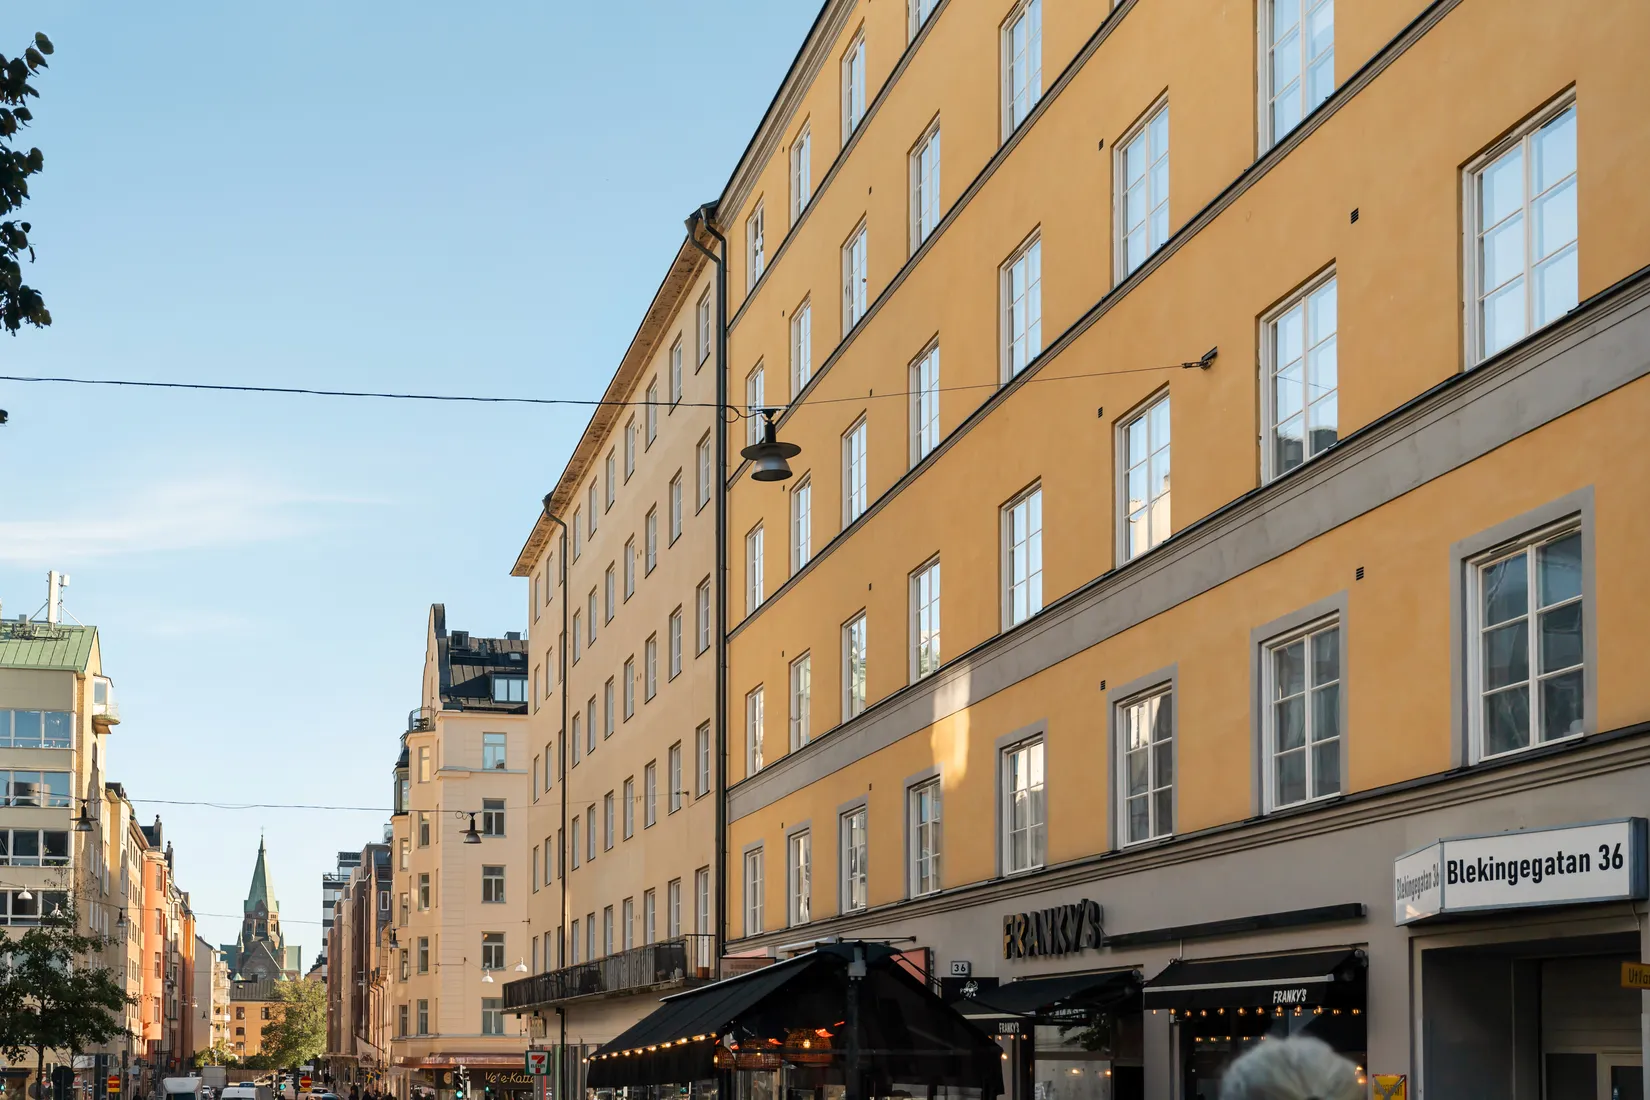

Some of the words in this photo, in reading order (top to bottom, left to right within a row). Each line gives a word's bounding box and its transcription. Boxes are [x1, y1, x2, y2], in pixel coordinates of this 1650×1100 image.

[1447, 851, 1591, 886] Blekingegatan
[1598, 843, 1624, 871] 36
[1397, 869, 1432, 902] Blekingegatan
[1003, 898, 1101, 959] FRANKY'S
[954, 964, 966, 972] 36
[1272, 988, 1307, 1004] FRANKY'S
[998, 1022, 1019, 1033] FRANKY'S
[531, 1055, 545, 1074] 7
